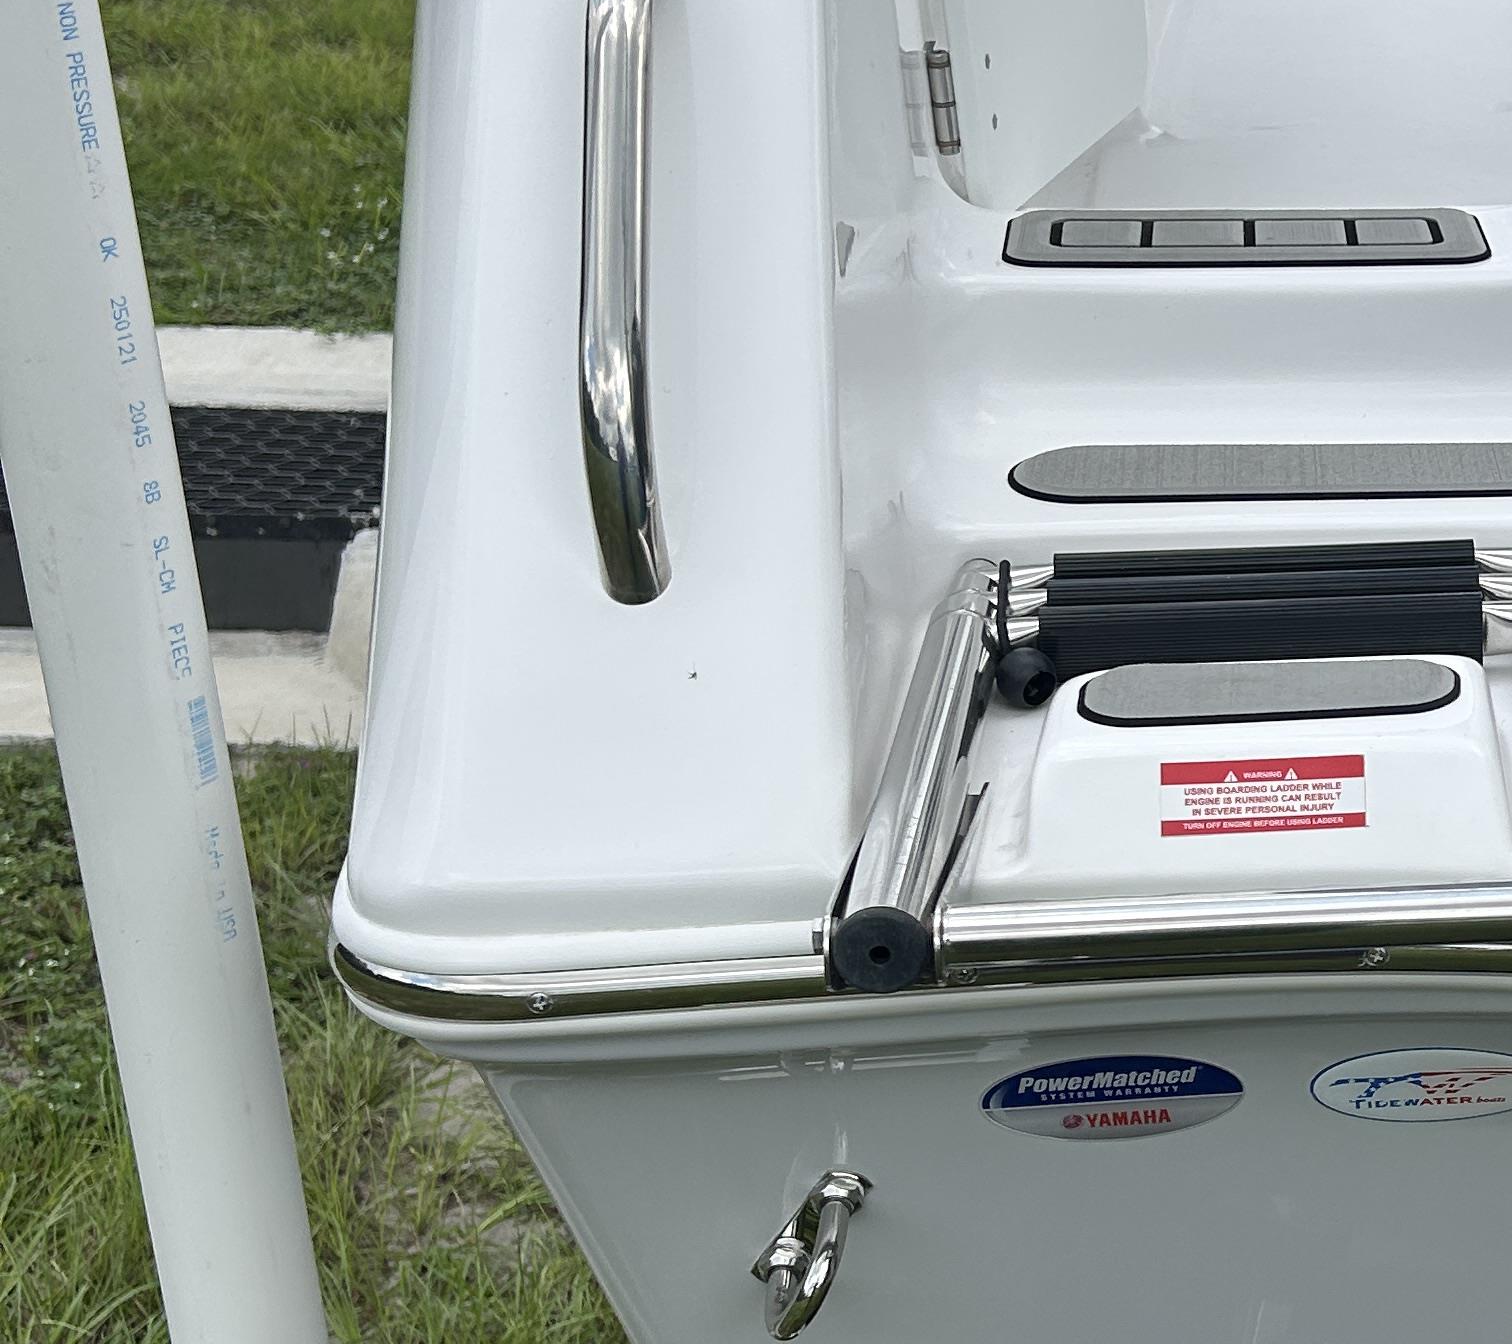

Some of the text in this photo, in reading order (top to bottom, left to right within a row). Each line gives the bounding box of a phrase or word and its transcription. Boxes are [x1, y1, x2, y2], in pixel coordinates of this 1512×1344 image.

[57, 1, 80, 42] NON
[65, 51, 100, 153] PRESSURE
[99, 236, 119, 263] OK
[110, 295, 138, 366] 250121
[128, 400, 153, 449] 2045
[153, 535, 177, 595] SL-CM
[1242, 770, 1283, 780] WARNING
[1183, 781, 1342, 796] USING BOARDING LADDER WHILE
[1184, 791, 1342, 807] ENGINE IS RUNNING CAN RESULT
[1191, 802, 1335, 817] IN SEVERE PERSONAL INJURY
[1182, 816, 1345, 831] TURN OFF ENGINE BEFORE USING LADDER
[1017, 1065, 1198, 1095] PowerMatched
[1040, 1084, 1180, 1102] SYSTEM WARRANTY
[1349, 1096, 1474, 1110] TIDEWATER
[1086, 1108, 1172, 1129] YAMAHA
